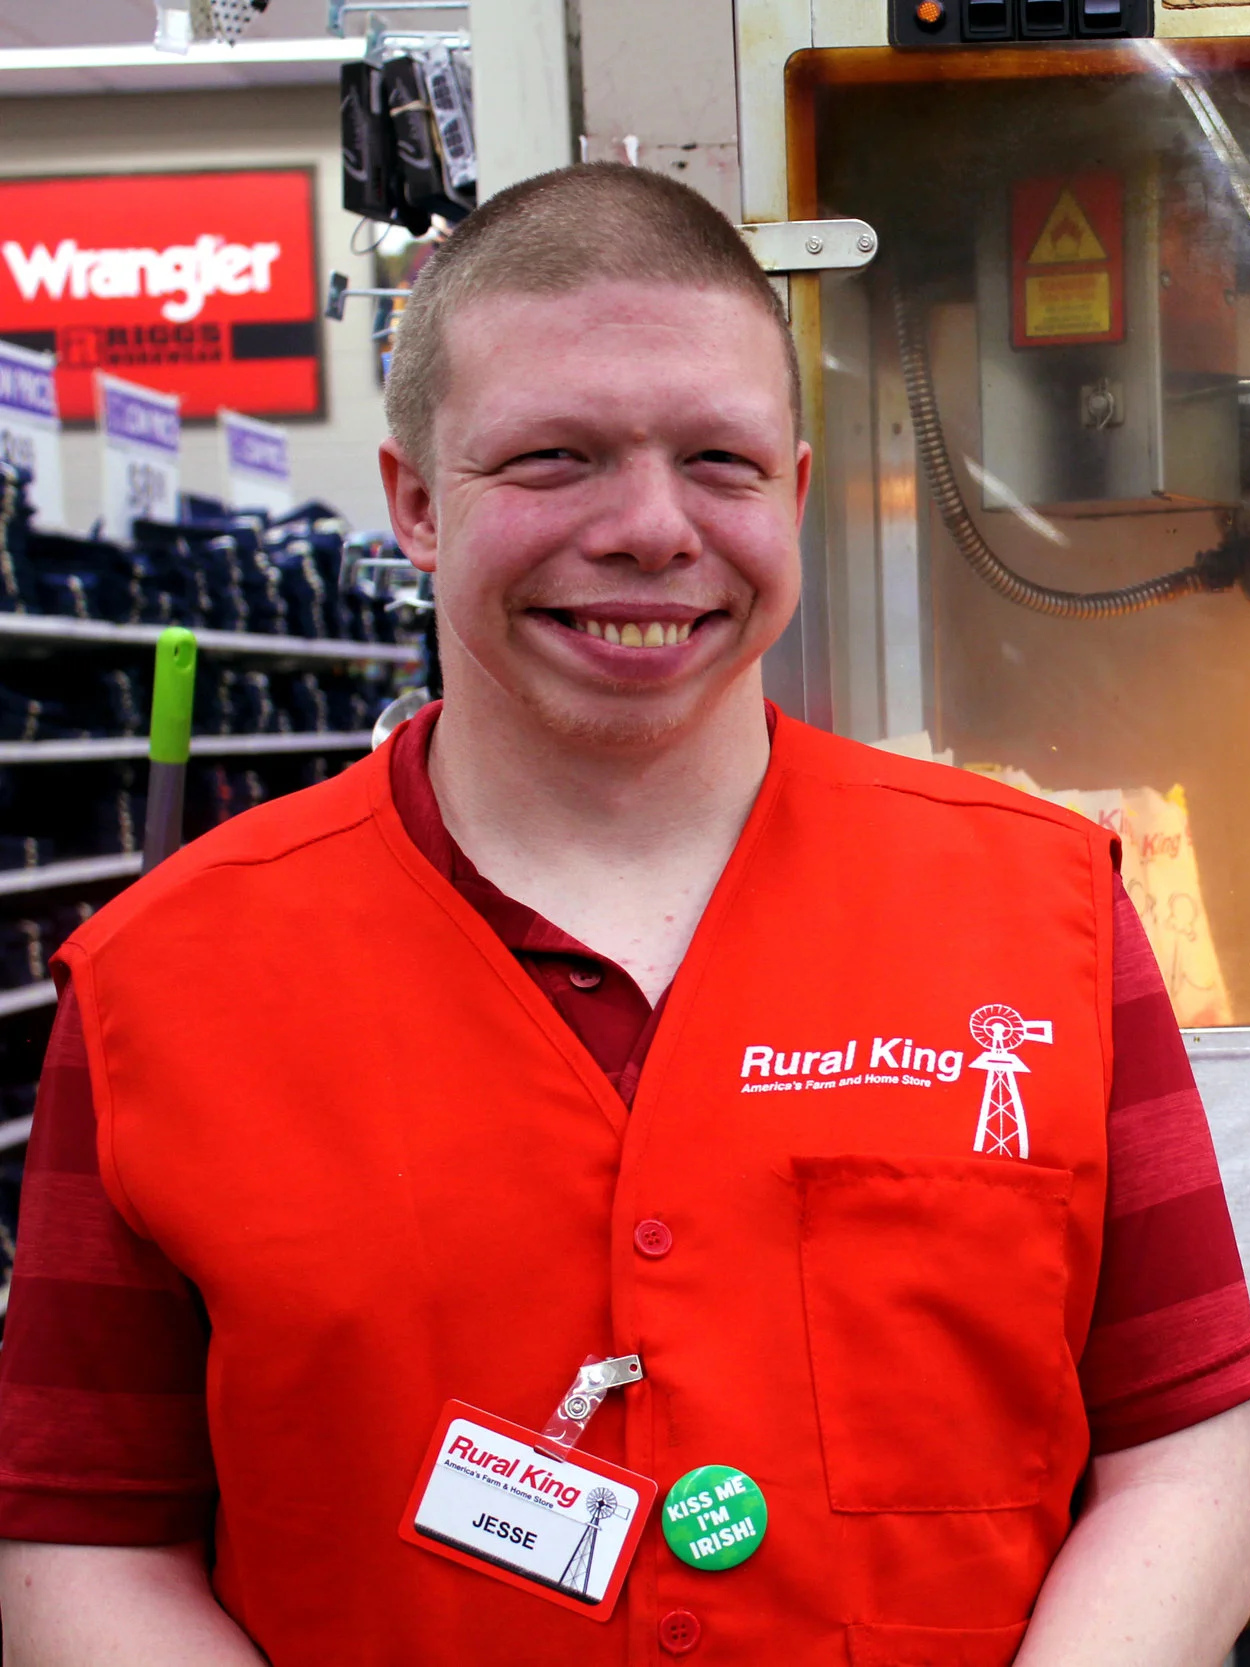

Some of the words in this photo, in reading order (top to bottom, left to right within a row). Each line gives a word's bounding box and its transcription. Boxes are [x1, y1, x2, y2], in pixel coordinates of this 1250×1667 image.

[2, 234, 280, 323] Wrangler
[106, 322, 222, 347] RIGGS
[740, 1039, 857, 1078] Rural
[869, 1037, 964, 1082] King
[741, 1080, 802, 1093] America's
[805, 1079, 836, 1090] Farm
[838, 1074, 862, 1086] and
[864, 1073, 899, 1085] Home
[901, 1074, 932, 1088] Store
[444, 1459, 481, 1479] America's
[482, 1474, 501, 1488] Farm
[510, 1486, 532, 1500] Home
[533, 1495, 554, 1509] Store
[448, 1435, 520, 1478] Rural
[518, 1464, 582, 1508] King
[666, 1491, 713, 1522] KISS
[714, 1475, 746, 1502] ME
[696, 1505, 730, 1531] I'M
[472, 1512, 538, 1550] JESSE
[689, 1516, 757, 1560] IRISH!
